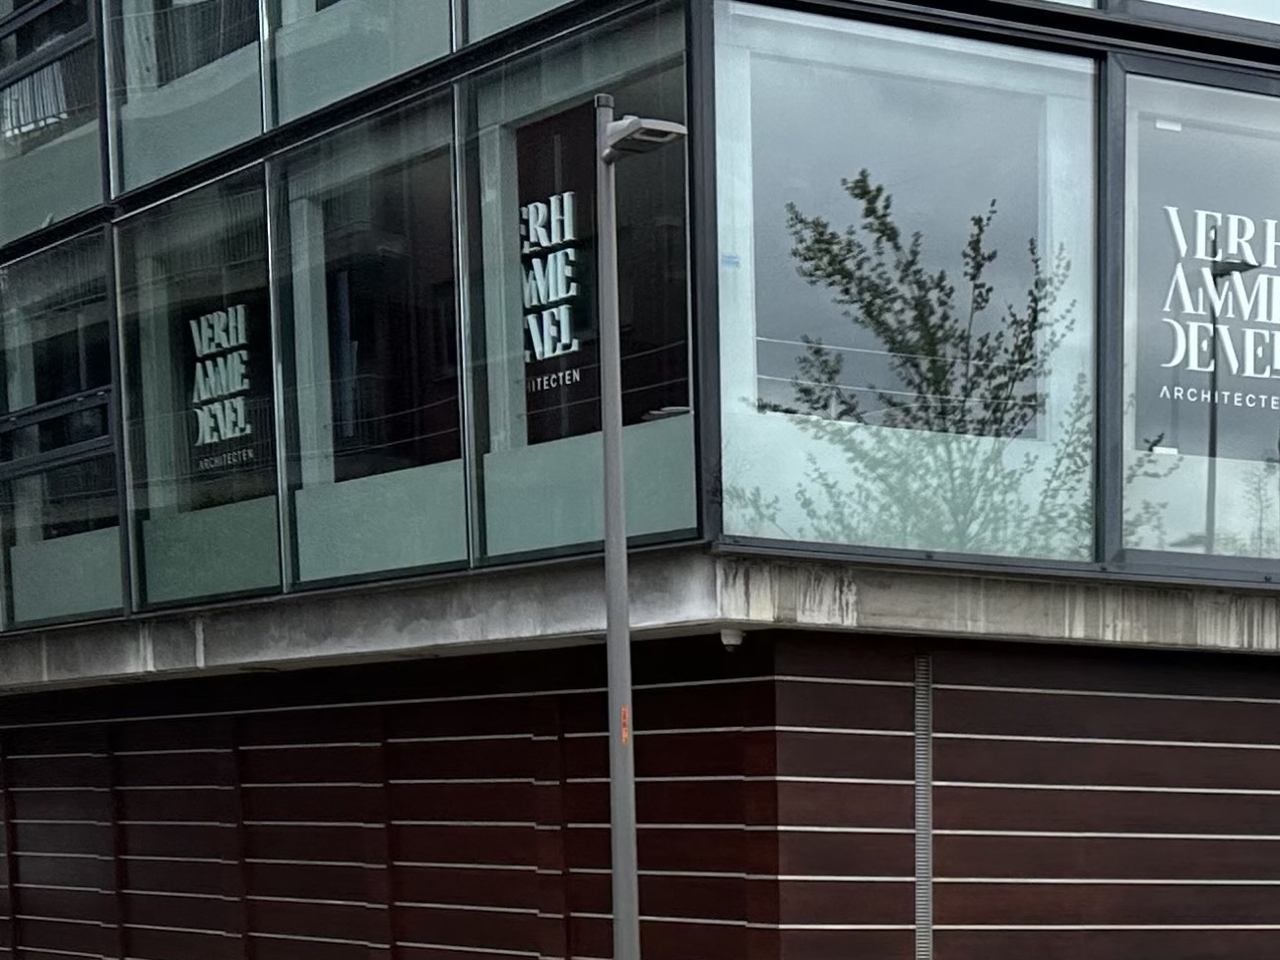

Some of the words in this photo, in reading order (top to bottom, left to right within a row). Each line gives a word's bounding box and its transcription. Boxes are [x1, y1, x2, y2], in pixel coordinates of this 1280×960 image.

[189, 304, 248, 358] VERH
[192, 349, 250, 403] AMME
[198, 449, 254, 471] ARCHITECTEN
